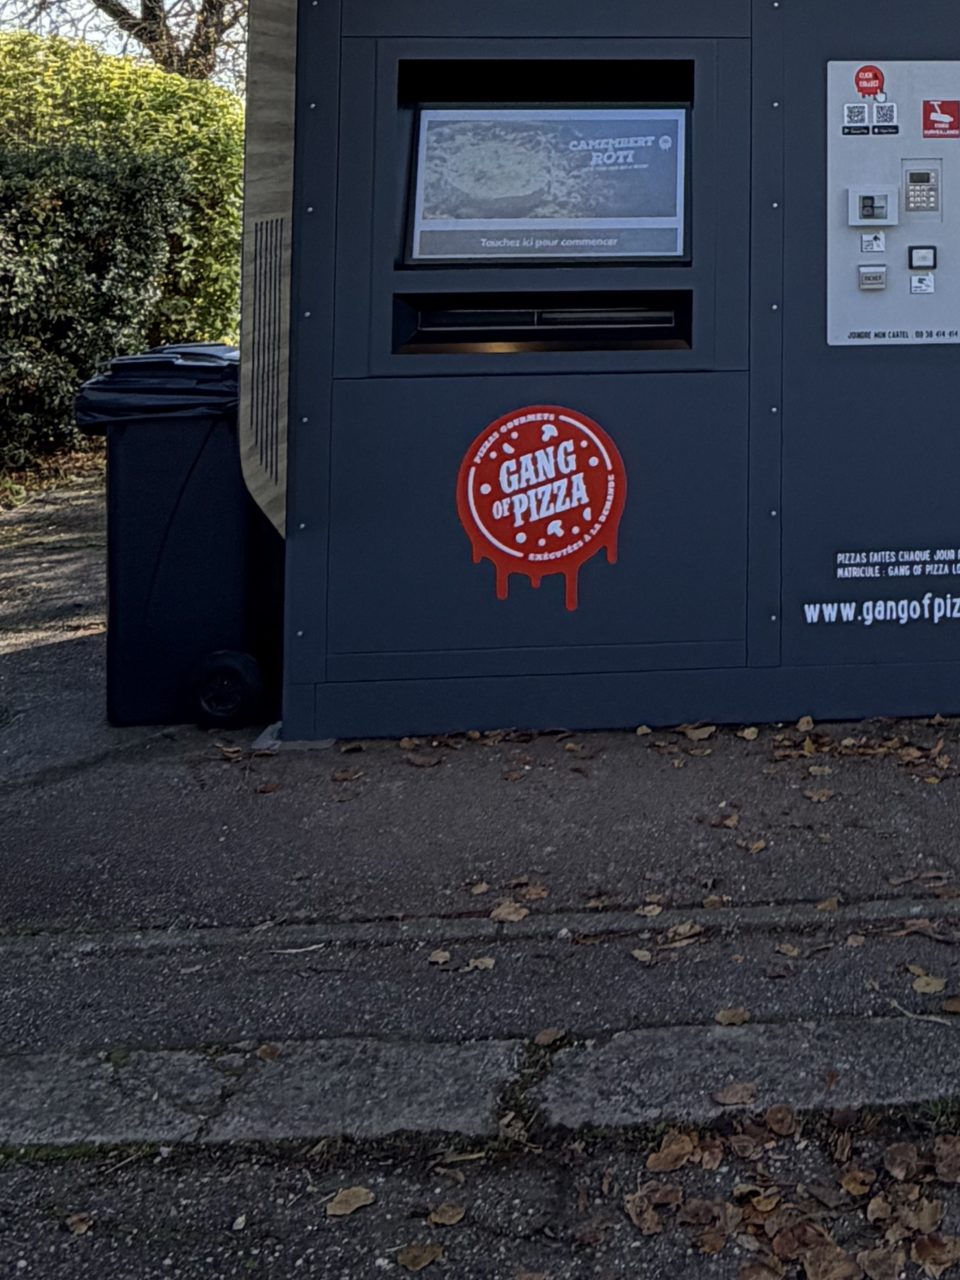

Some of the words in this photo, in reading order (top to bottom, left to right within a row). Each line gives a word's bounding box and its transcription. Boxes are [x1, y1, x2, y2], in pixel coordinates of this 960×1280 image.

[569, 136, 656, 151] CAMEMBERT
[480, 238, 520, 248] Touchez
[535, 239, 559, 249] pour
[560, 238, 619, 247] commencer
[887, 330, 909, 339] CARTEL
[473, 431, 500, 464] PIZZAS
[499, 439, 577, 494] GANG
[492, 497, 511, 520] OF
[511, 472, 590, 528] PIZZA
[598, 474, 616, 523] DEMANDE
[836, 551, 867, 565] PIZZAS
[869, 550, 897, 564] FAITES
[898, 549, 931, 563] CHAQUE
[933, 548, 955, 561] JOUR
[836, 565, 881, 579] MATRICULE
[887, 565, 911, 578] GANG
[912, 564, 923, 576] OF
[925, 563, 950, 576] PIZZA
